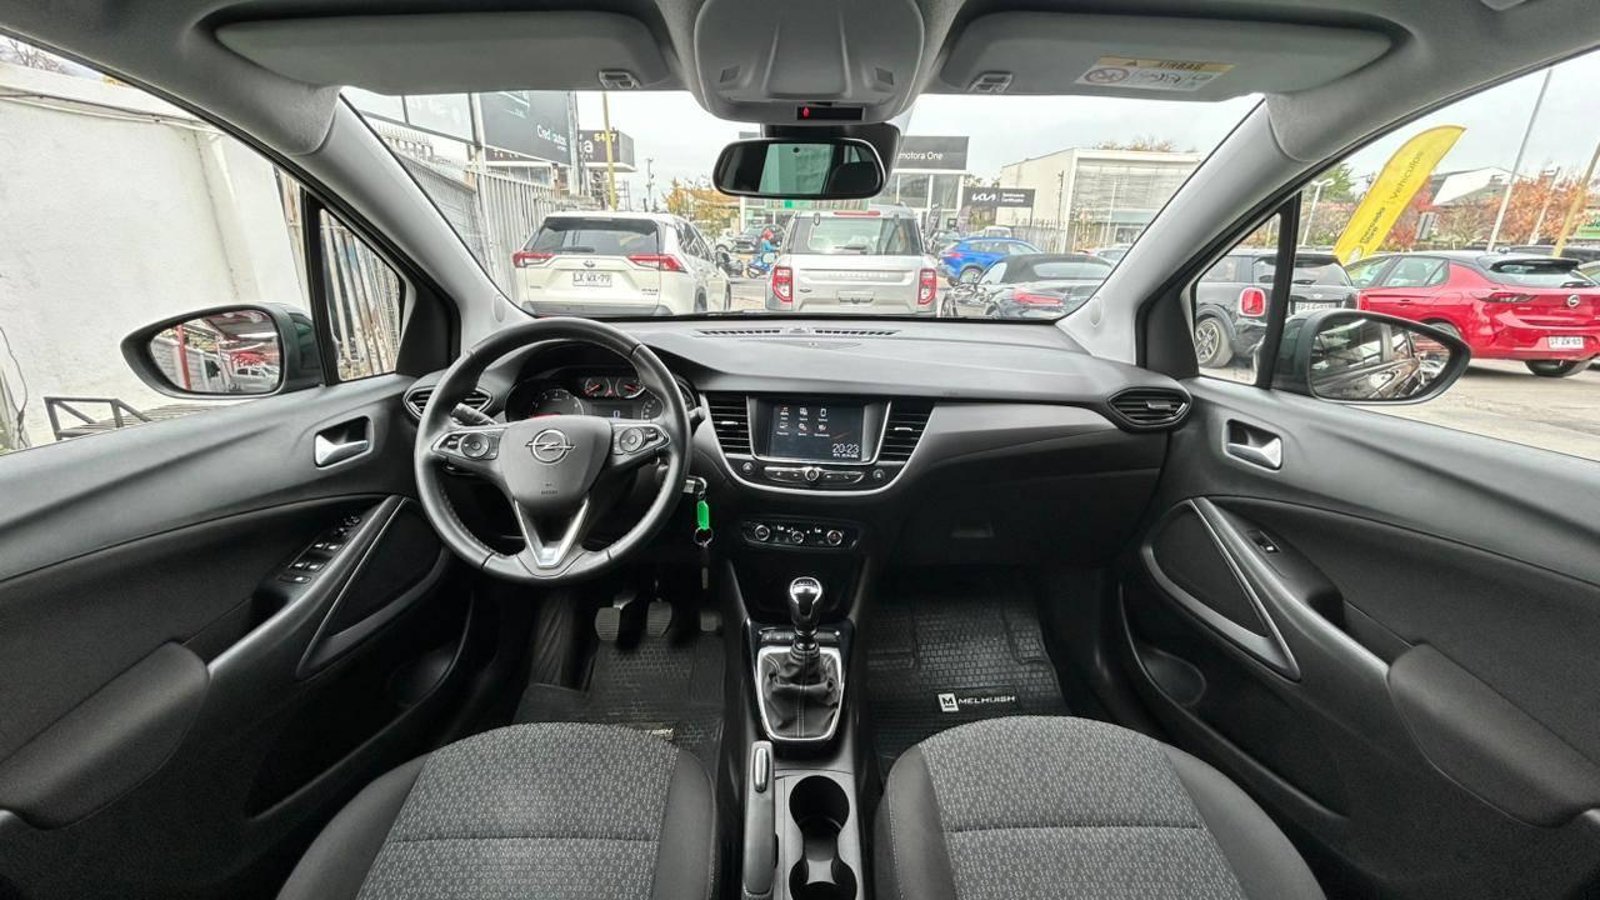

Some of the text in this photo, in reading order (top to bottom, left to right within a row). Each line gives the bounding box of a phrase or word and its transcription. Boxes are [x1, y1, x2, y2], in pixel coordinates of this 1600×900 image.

[594, 132, 617, 142] 547
[898, 150, 943, 160] motora One
[958, 695, 1016, 705] MELHUISH
